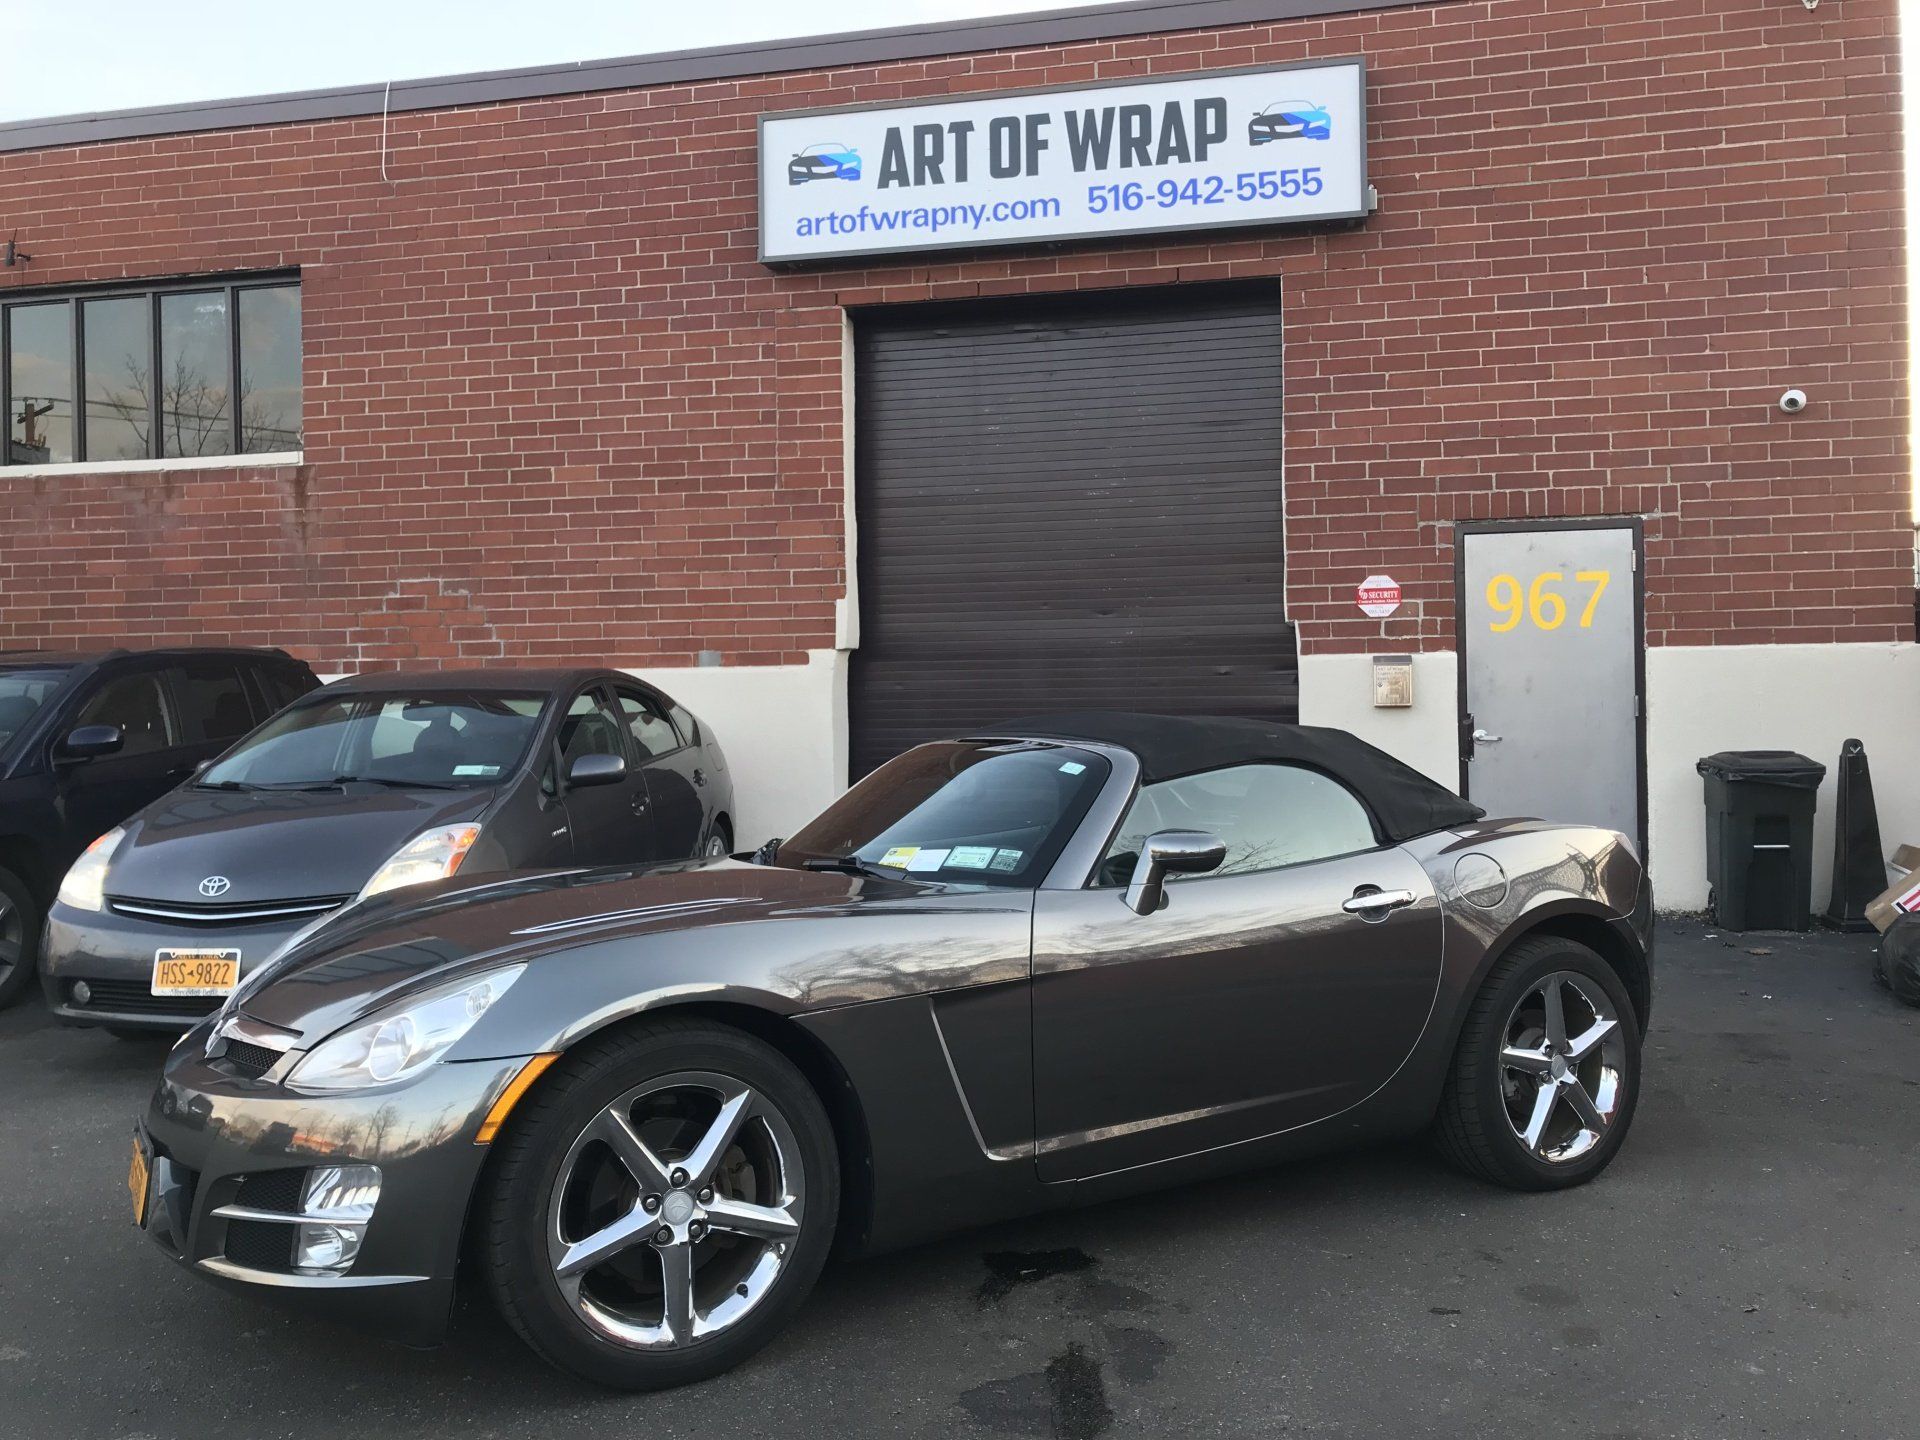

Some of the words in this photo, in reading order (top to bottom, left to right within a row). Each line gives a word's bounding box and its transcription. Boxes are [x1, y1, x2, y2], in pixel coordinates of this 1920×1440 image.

[877, 120, 975, 189] ART
[989, 112, 1052, 179] OF
[1064, 96, 1227, 173] WRAP
[1088, 167, 1323, 214] 516-942-5555
[796, 197, 1061, 236] artofwrapny.com
[1369, 591, 1399, 599] SECURITY
[1486, 570, 1610, 632] 967
